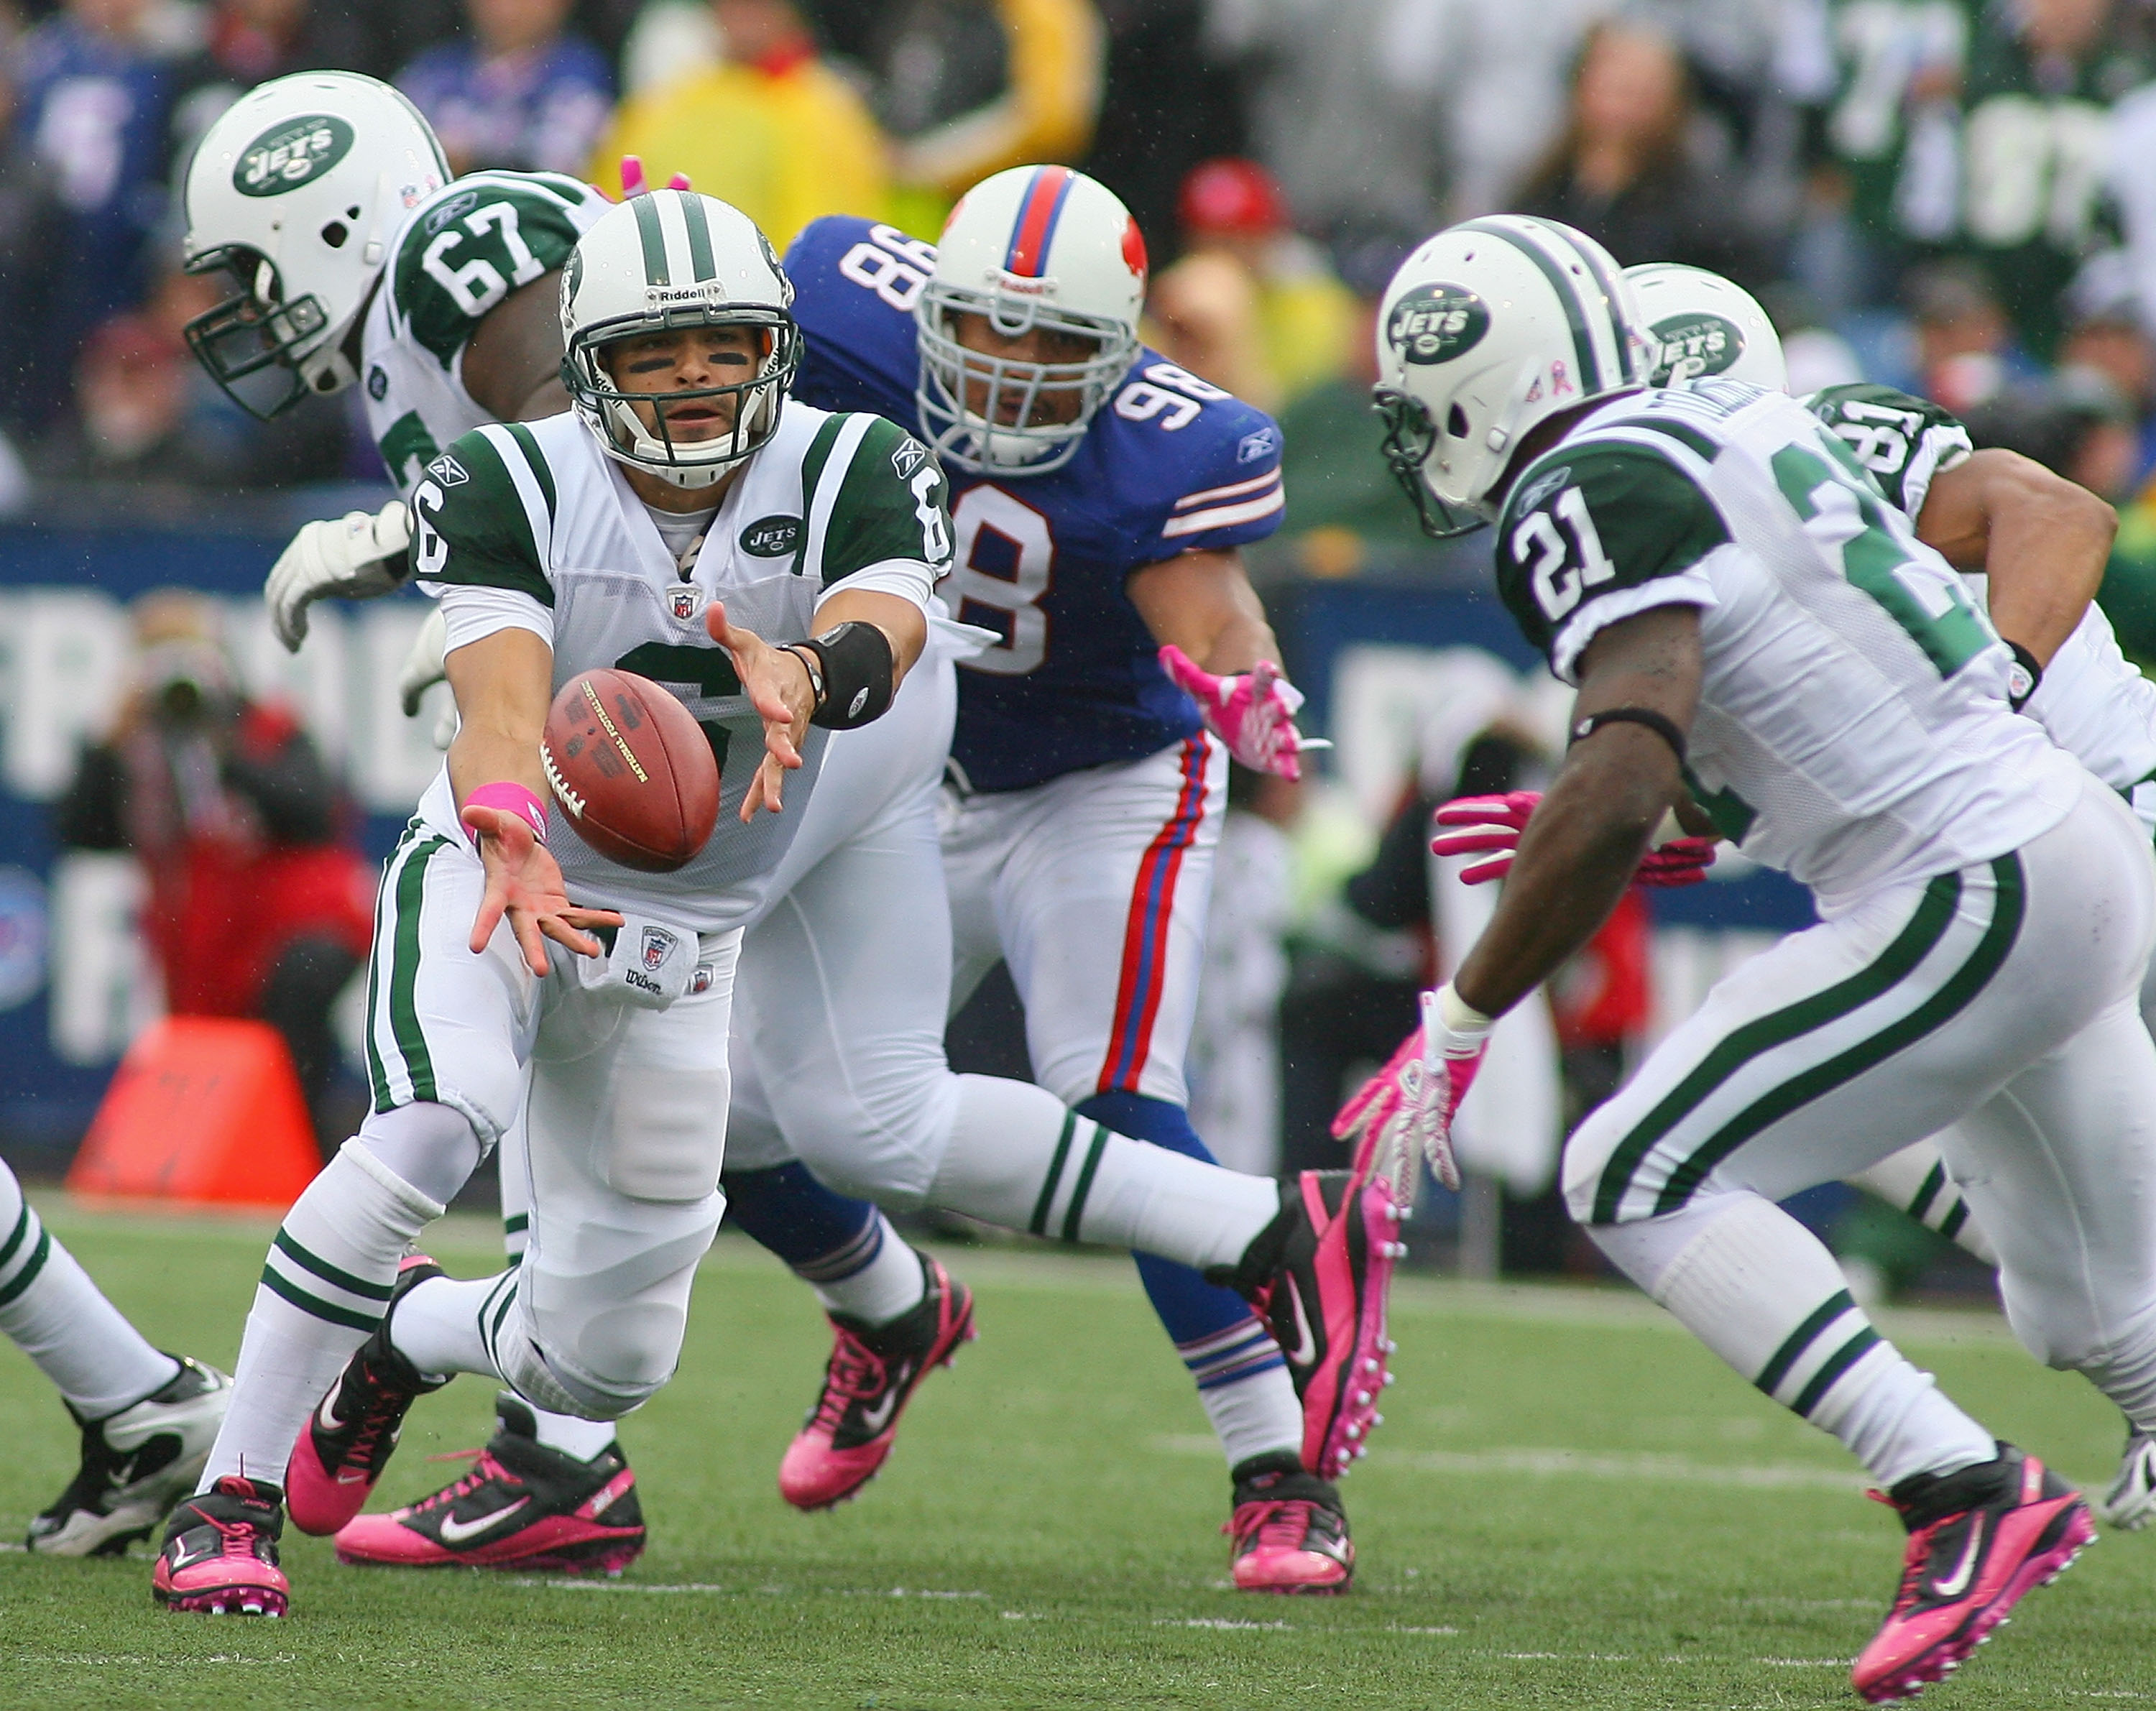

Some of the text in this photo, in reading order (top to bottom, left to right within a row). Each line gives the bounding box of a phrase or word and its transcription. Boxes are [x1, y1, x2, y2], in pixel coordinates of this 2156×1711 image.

[246, 128, 333, 185] JETS
[422, 200, 546, 317] 67
[660, 288, 706, 302] Riddell
[1391, 309, 1470, 341] JETS
[1663, 331, 1726, 365] ETS
[1113, 361, 1234, 431] 98
[1833, 400, 1925, 474] 81
[415, 479, 448, 573] 6
[750, 527, 797, 547] JETS
[911, 466, 951, 562] 6
[933, 480, 1054, 674] 8
[1512, 485, 1616, 621] 21
[591, 698, 619, 737] FOOTBALL
[614, 736, 649, 783] NATIONAL
[625, 968, 663, 995] Wilson
